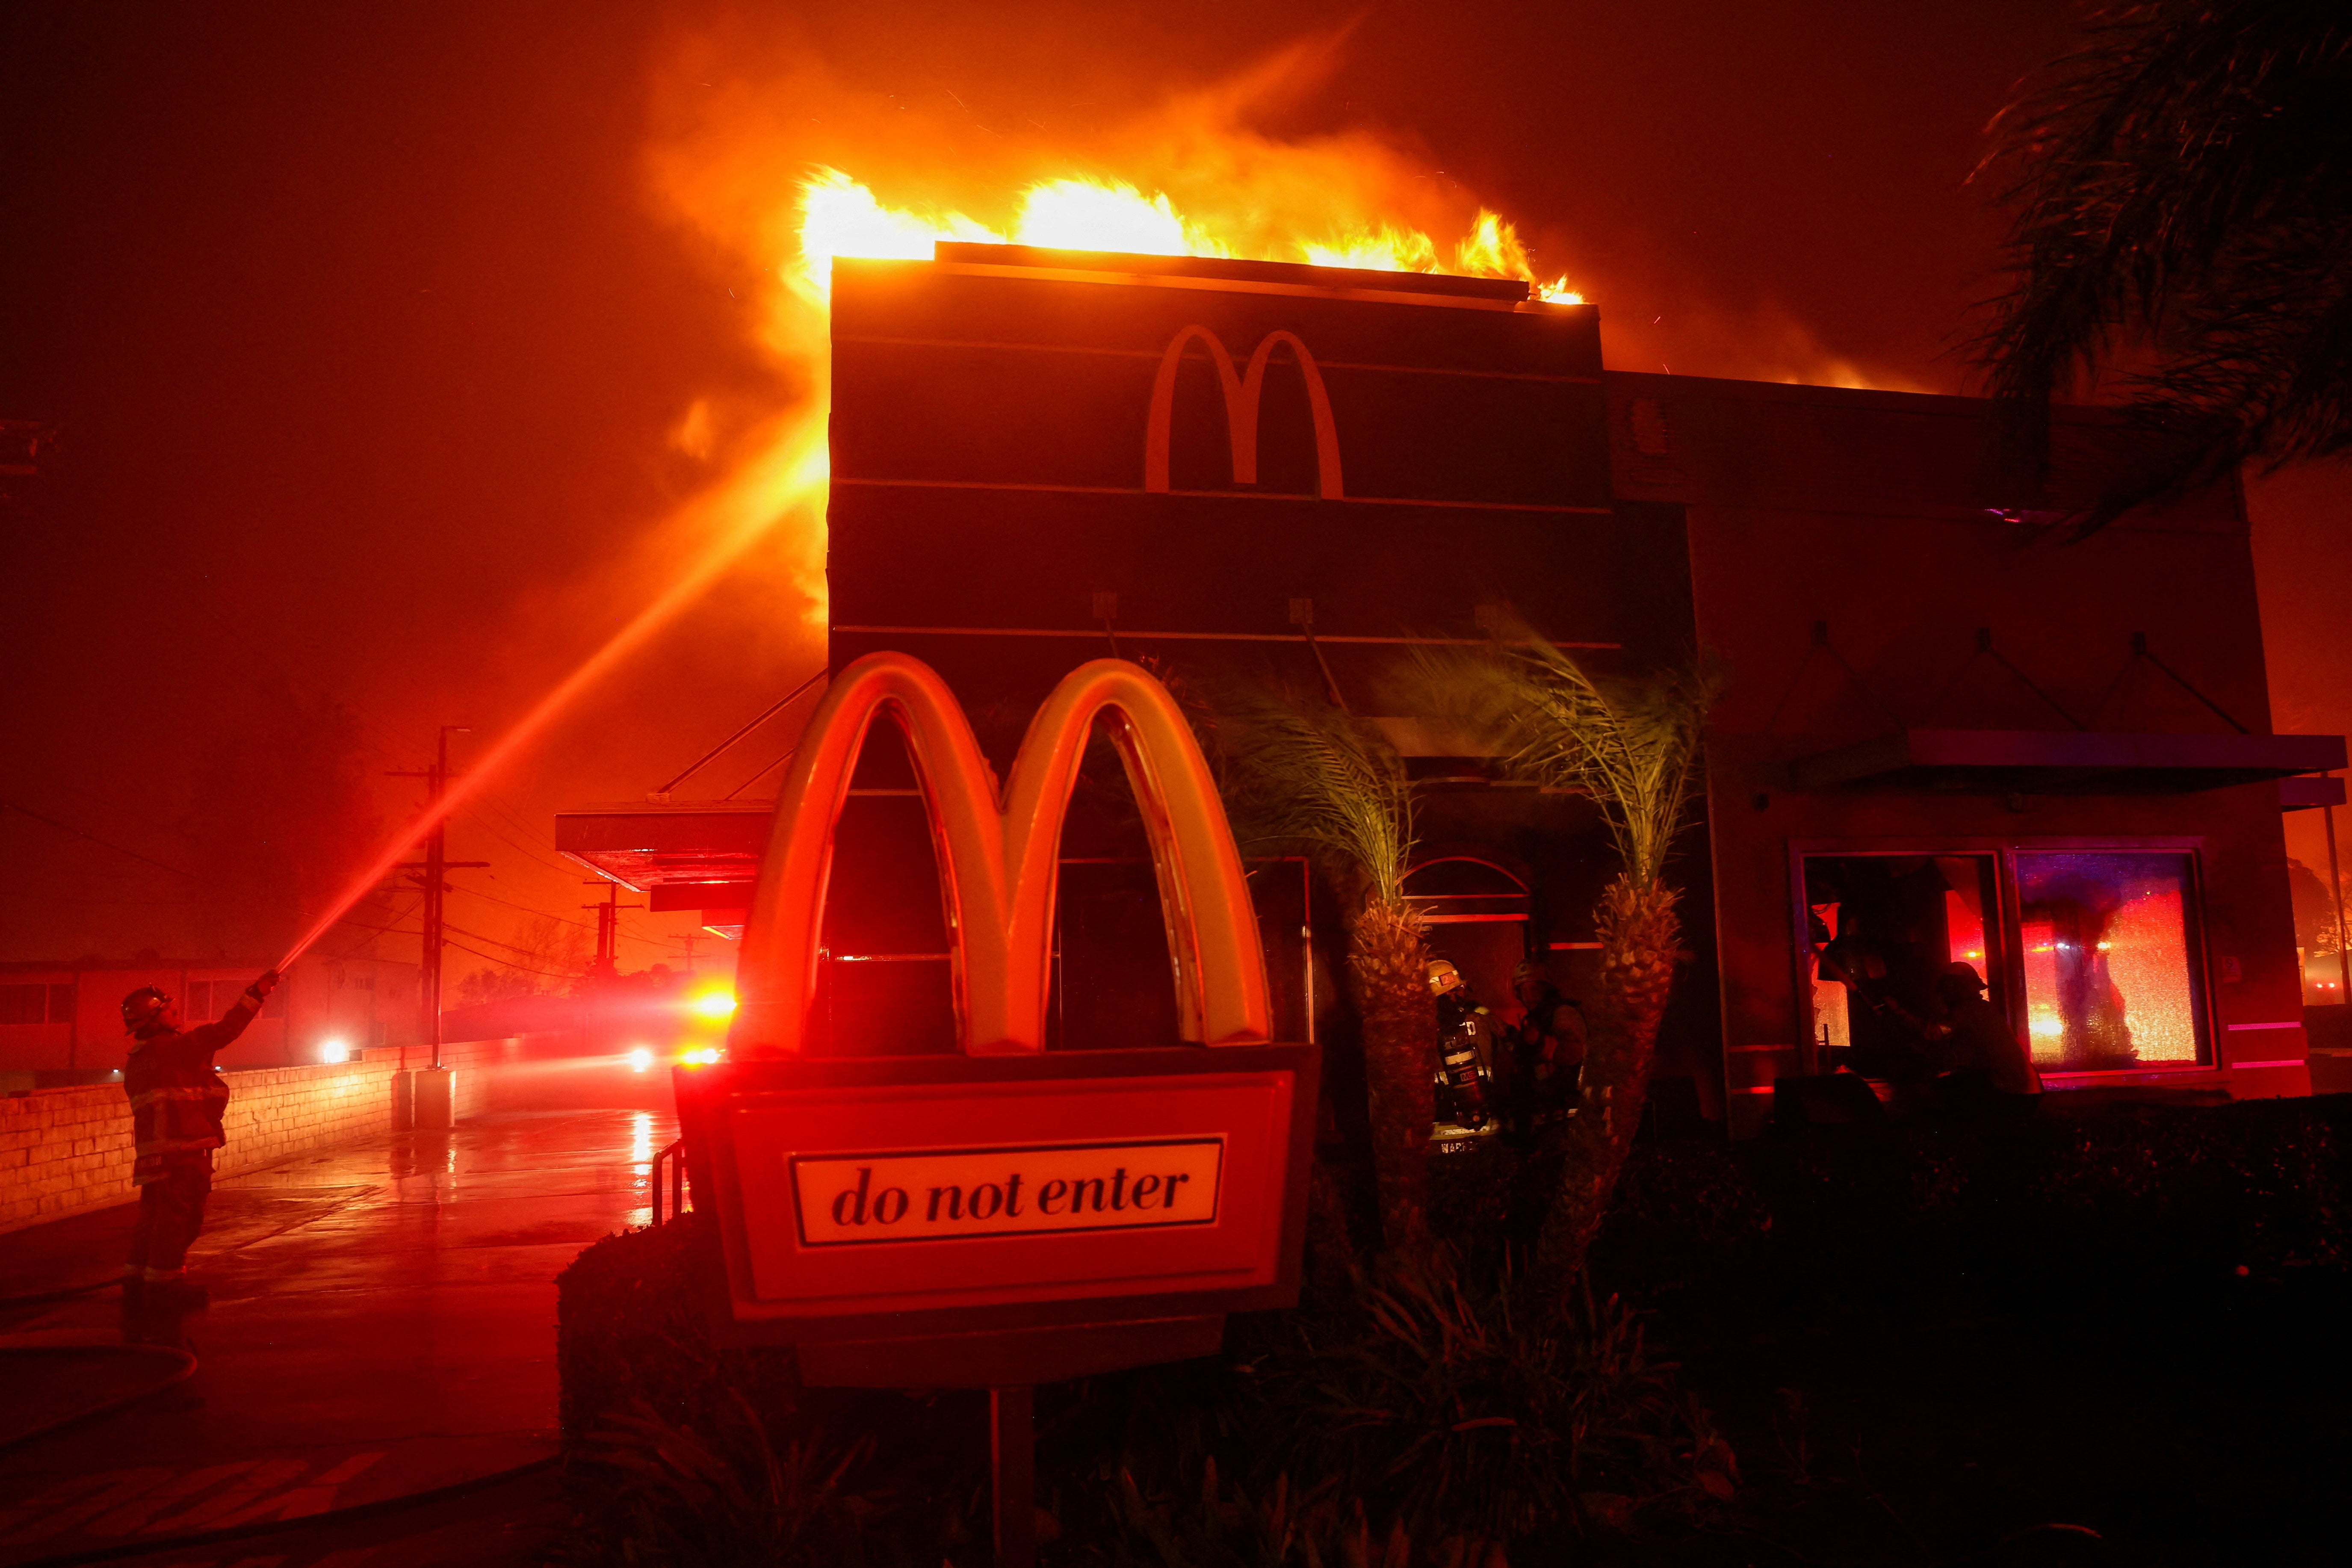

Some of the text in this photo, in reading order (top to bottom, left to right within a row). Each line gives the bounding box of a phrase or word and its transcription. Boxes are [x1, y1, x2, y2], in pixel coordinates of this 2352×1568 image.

[832, 1168, 1190, 1226] do not enter
